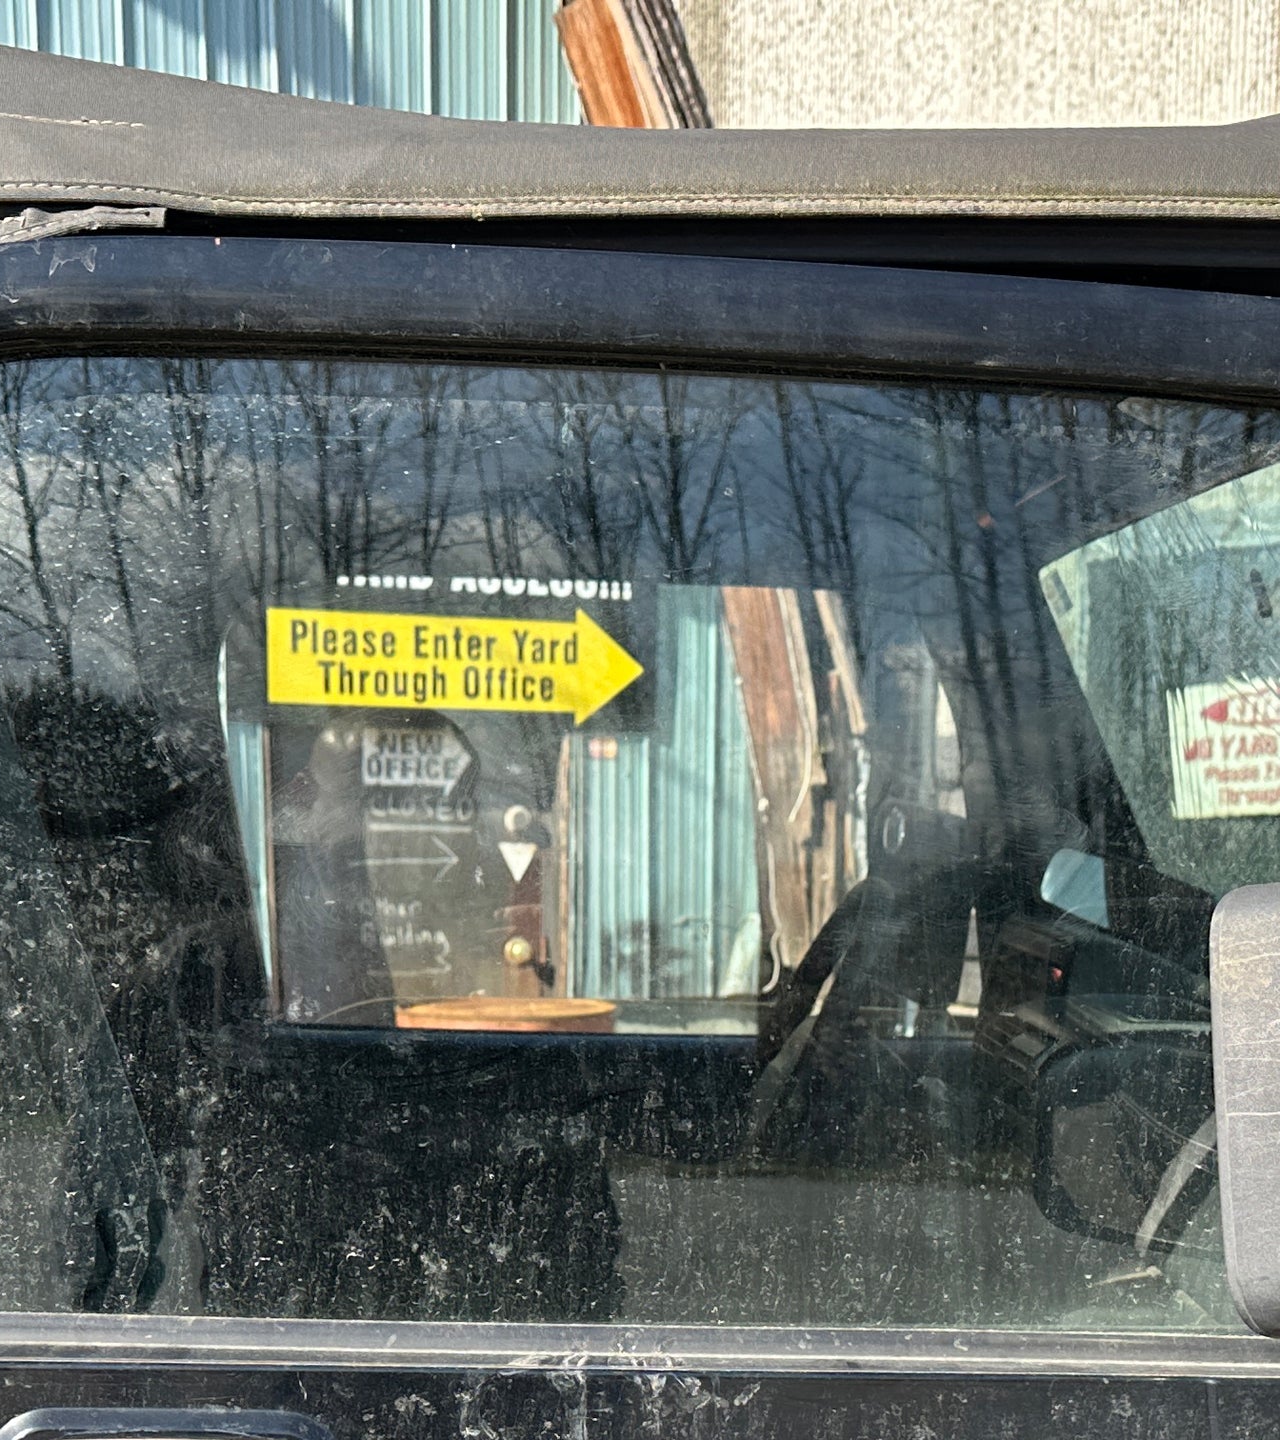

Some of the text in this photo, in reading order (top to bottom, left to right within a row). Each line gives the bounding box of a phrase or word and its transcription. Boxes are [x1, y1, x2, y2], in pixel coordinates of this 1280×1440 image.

[290, 619, 580, 665] Please Enter Yard
[317, 661, 556, 703] Through Office
[377, 732, 443, 755] NEW
[367, 756, 458, 780] OFFICE
